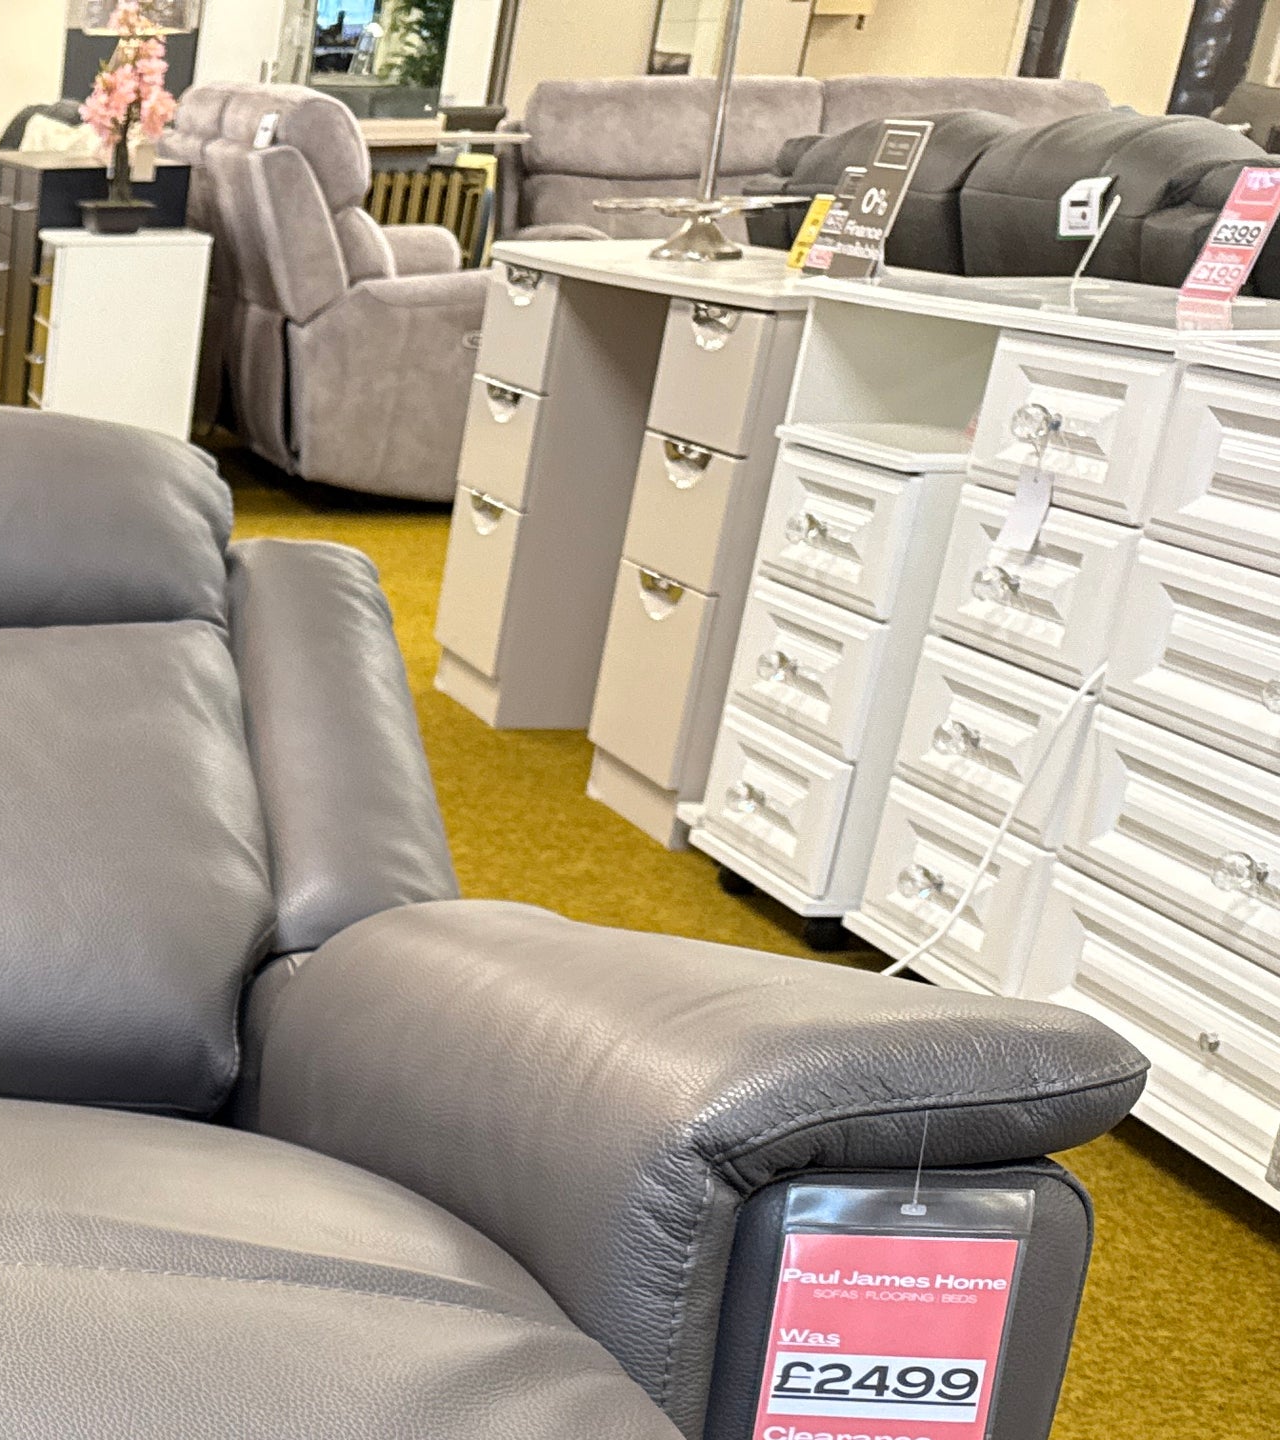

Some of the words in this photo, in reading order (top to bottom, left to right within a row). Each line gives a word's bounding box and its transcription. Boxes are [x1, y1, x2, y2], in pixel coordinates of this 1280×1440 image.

[861, 187, 888, 216] 0%
[1213, 223, 1262, 245] £399
[782, 1268, 840, 1285] Paul
[843, 1271, 930, 1288] James
[934, 1274, 1007, 1291] Home
[813, 1288, 858, 1300] SOFAS
[865, 1290, 934, 1303] FLOORING
[941, 1293, 978, 1304] BEDS
[778, 1327, 841, 1345] Was
[773, 1361, 979, 1401] £2499
